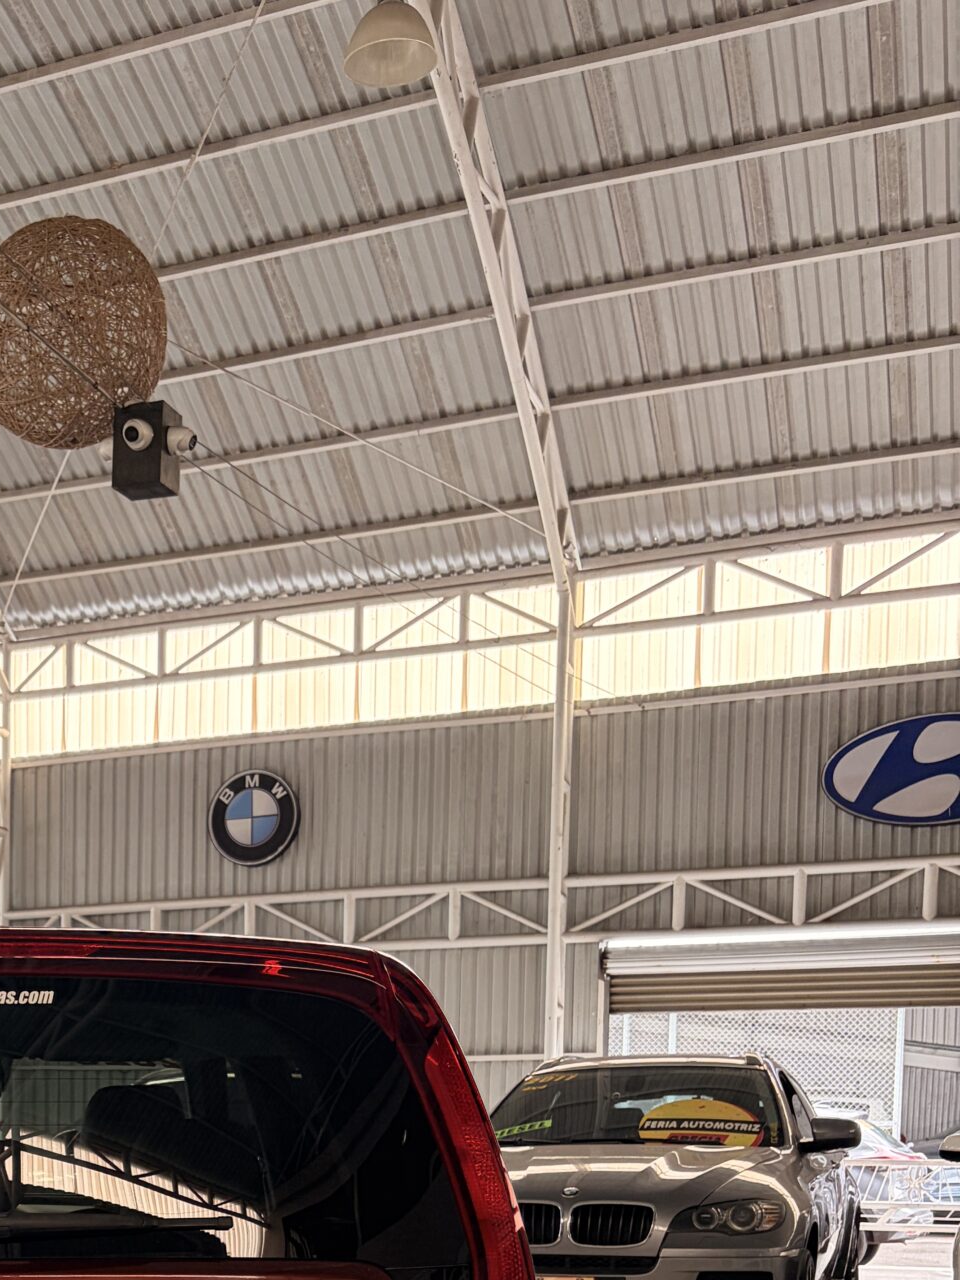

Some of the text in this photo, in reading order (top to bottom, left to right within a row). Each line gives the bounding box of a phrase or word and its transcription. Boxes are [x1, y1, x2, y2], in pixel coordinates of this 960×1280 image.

[219, 773, 288, 805] BMW
[643, 1120, 761, 1132] FERIA AUTOMOTRIZ
